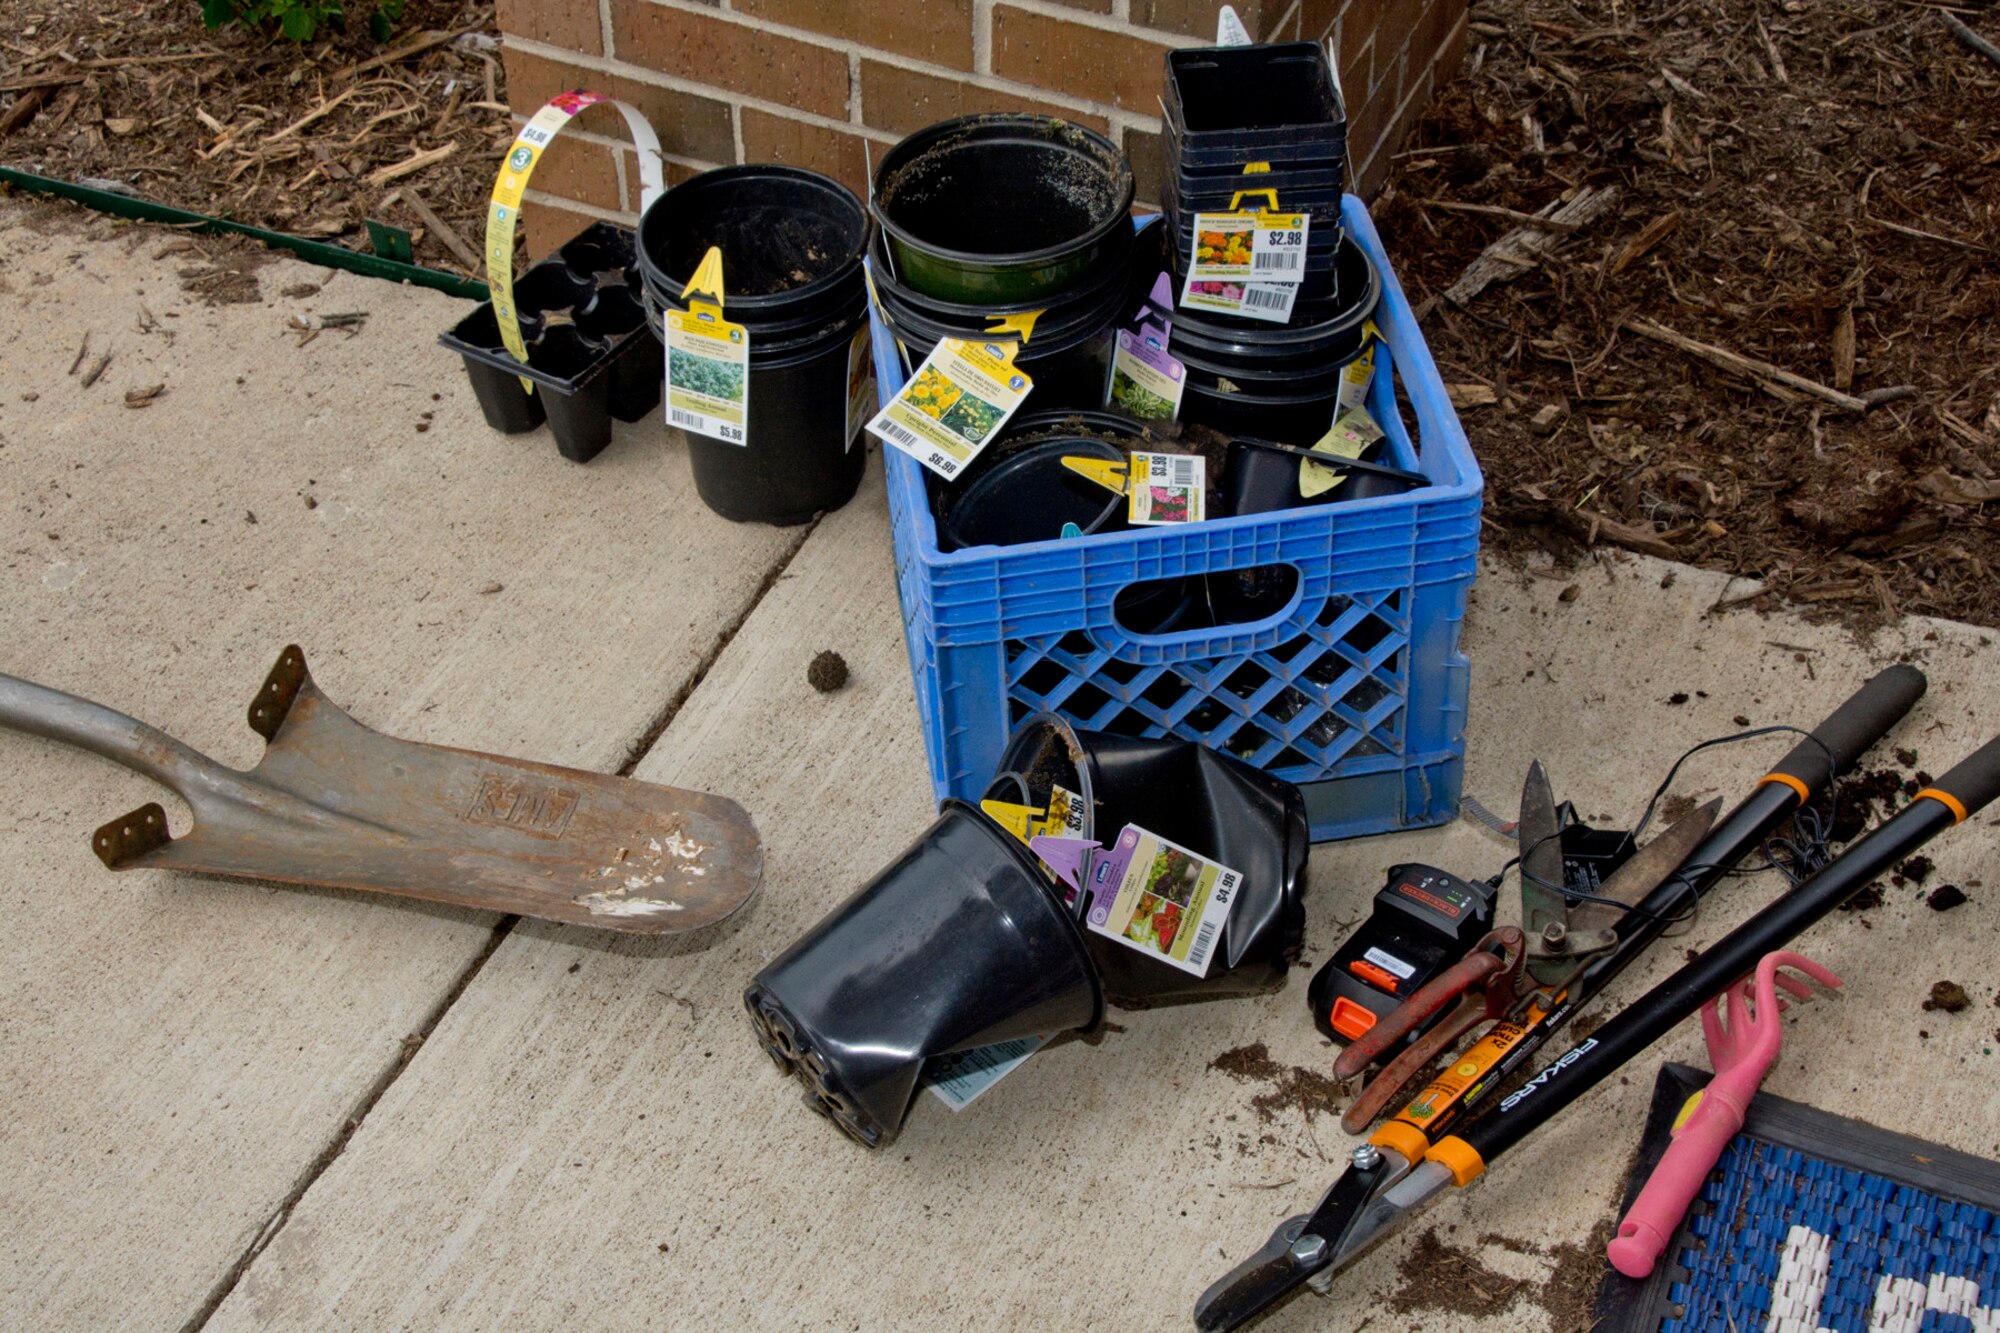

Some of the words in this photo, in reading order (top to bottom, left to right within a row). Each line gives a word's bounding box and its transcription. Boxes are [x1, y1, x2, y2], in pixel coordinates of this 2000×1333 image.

[1269, 231, 1302, 246] $2.98
[720, 425, 742, 441] $5.98
[928, 453, 957, 474] $6.98
[1151, 455, 1167, 476] $3.98
[1067, 797, 1082, 831] $3.98
[1216, 872, 1236, 904] $4.98
[1500, 1038, 1599, 1109] FISKARS
